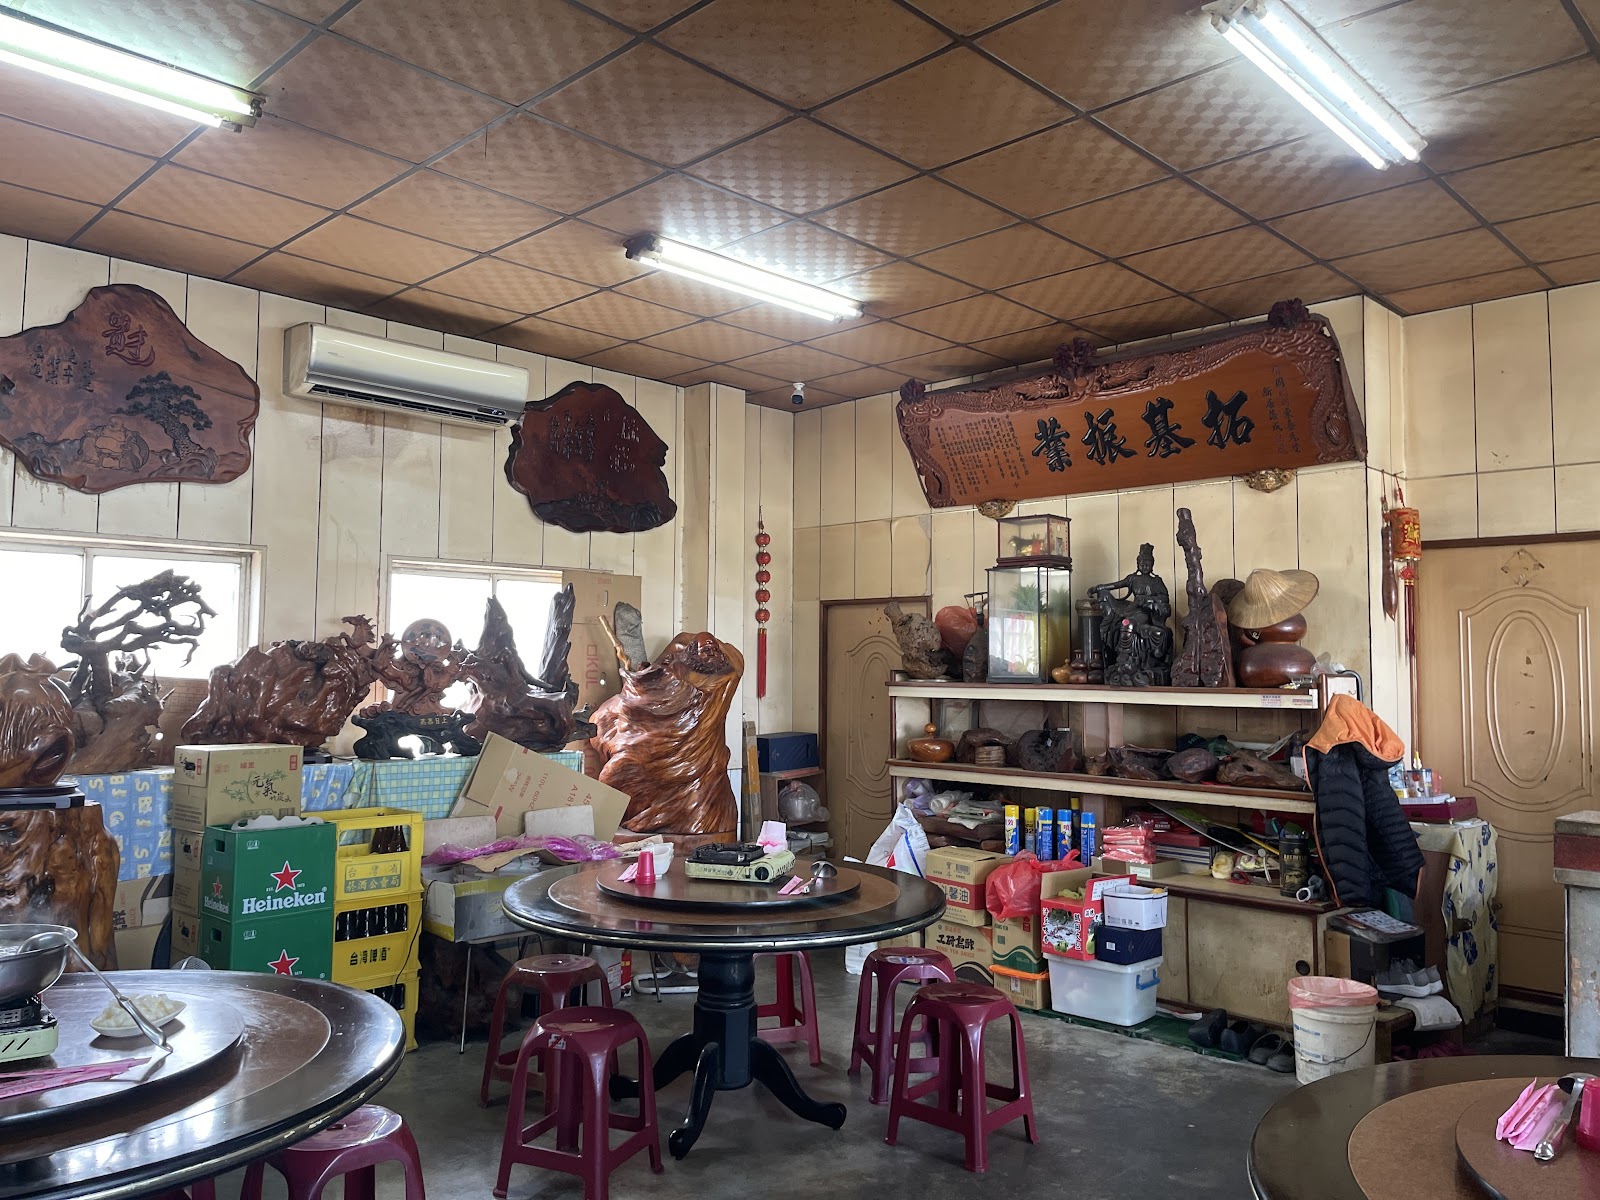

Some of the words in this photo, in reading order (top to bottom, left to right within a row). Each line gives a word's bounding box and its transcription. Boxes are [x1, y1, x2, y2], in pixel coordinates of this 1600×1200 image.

[252, 775, 277, 797] 元氣
[203, 895, 230, 914] Heineken
[241, 891, 326, 915] Heineken
